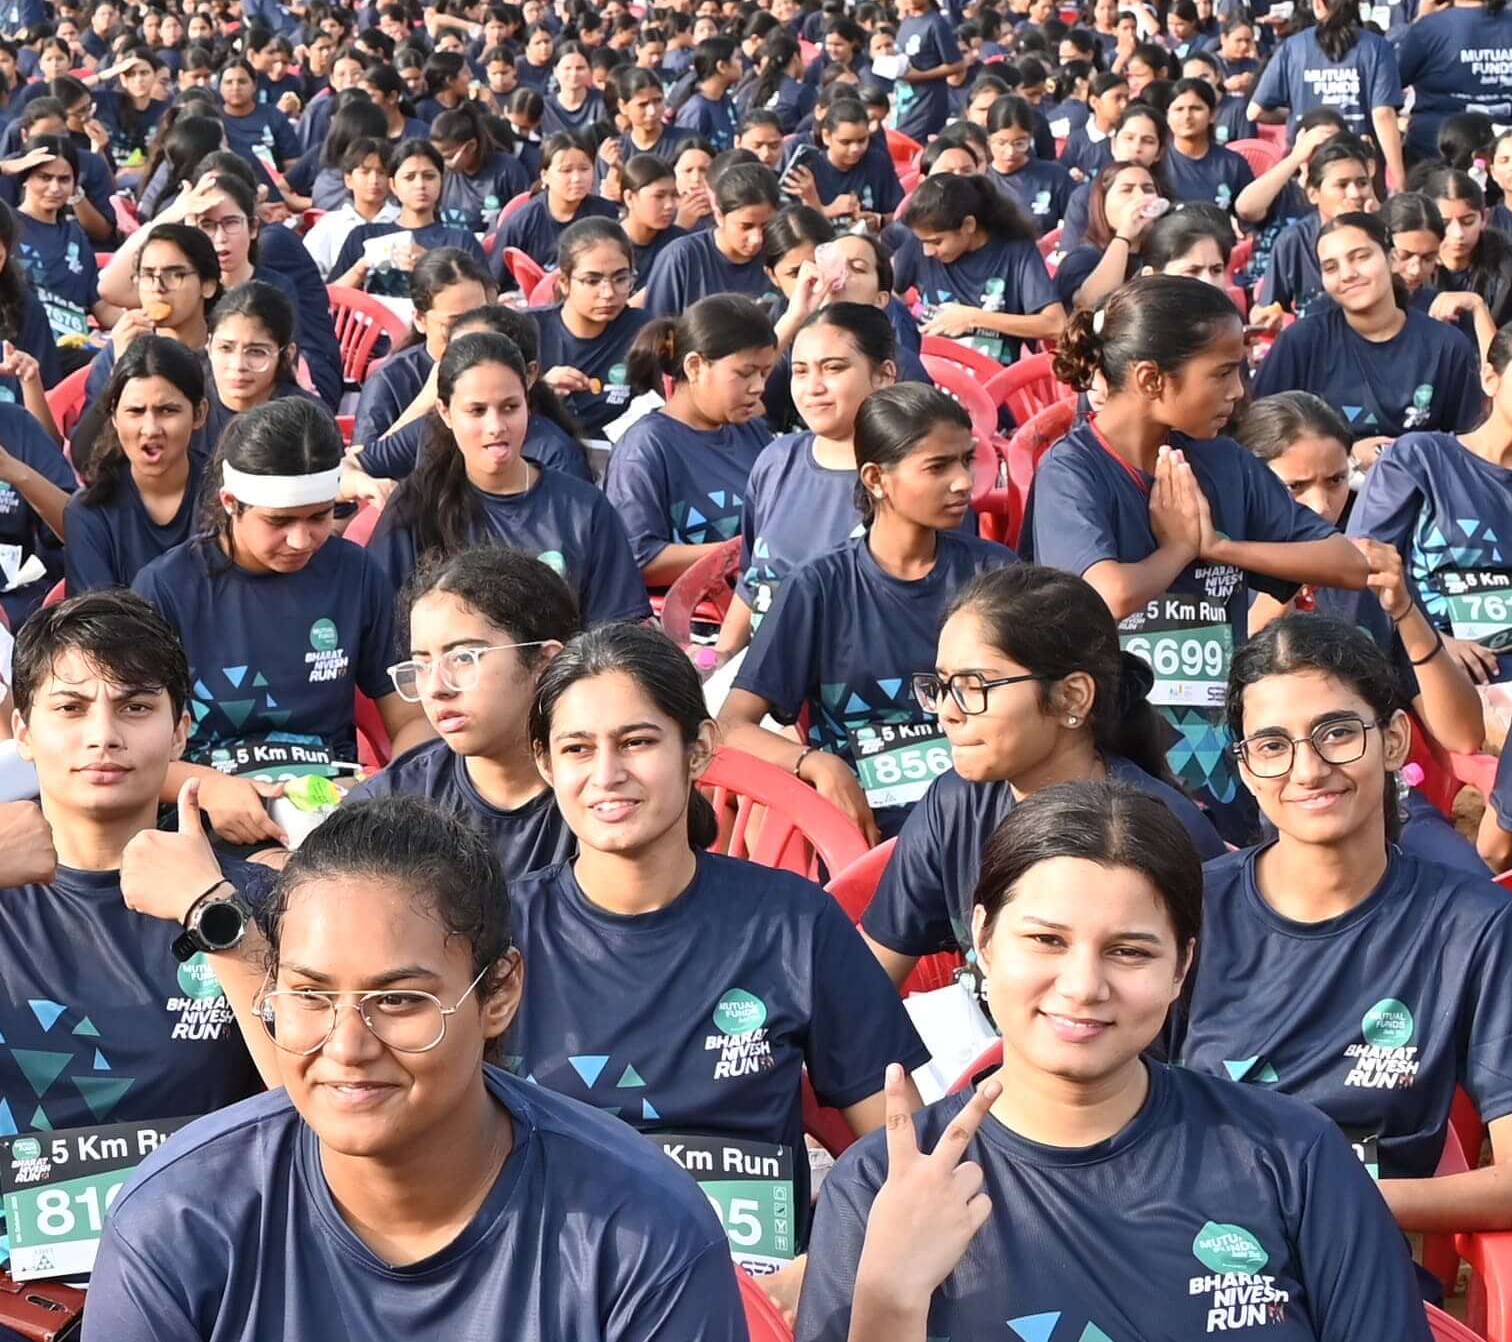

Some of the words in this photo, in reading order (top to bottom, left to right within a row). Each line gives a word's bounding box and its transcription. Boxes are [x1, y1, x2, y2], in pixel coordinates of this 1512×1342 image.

[1304, 68, 1360, 83] MUTUAL
[1313, 81, 1361, 96] FUNDS
[1479, 571, 1509, 586] Km
[1147, 600, 1159, 620] 5
[1166, 600, 1195, 621] Km
[1200, 602, 1226, 623] Run
[1126, 637, 1224, 677] 6699
[309, 669, 338, 683] RUN
[882, 727, 895, 742] 5
[898, 722, 932, 740] Km
[237, 750, 249, 764] 5
[252, 746, 288, 763] Km
[291, 746, 329, 764] Run
[171, 1022, 222, 1041] RUN
[1343, 1043, 1418, 1061] BHARAT
[713, 1055, 759, 1080] RUN
[1355, 1057, 1420, 1076] NIVESH
[1343, 1069, 1399, 1089] RUN
[52, 1139, 71, 1165] 5
[78, 1133, 131, 1161] Km
[664, 1143, 714, 1171] Km
[723, 1147, 780, 1178] Run
[1189, 1271, 1275, 1296] BHARAT
[1206, 1303, 1267, 1333] RUN
